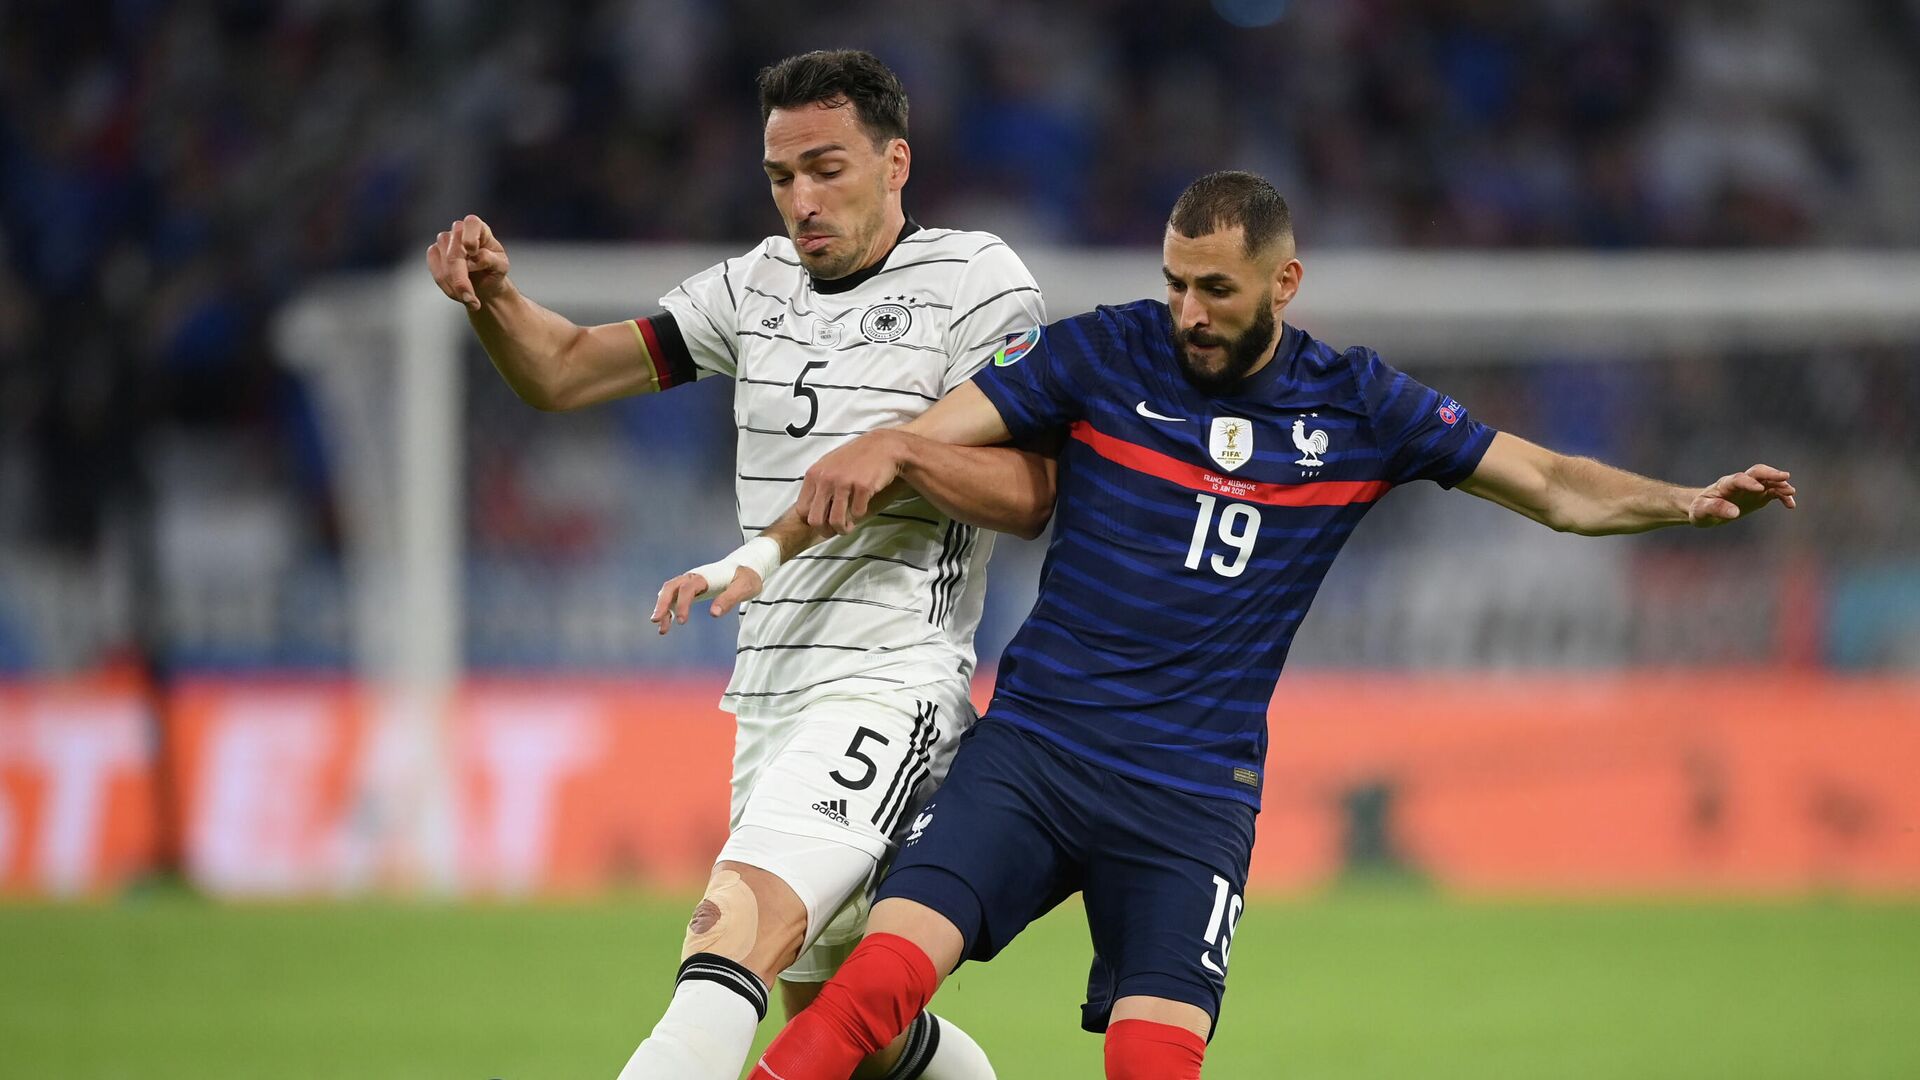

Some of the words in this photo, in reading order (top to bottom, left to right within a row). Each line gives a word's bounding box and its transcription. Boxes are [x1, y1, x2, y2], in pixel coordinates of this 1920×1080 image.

[786, 361, 829, 438] 5
[1222, 450, 1240, 458] FIFA
[1204, 474, 1223, 485] FRANCE
[1227, 480, 1256, 492] ALLEMAGNE
[1231, 487, 1246, 496] 2021
[1184, 493, 1262, 578] 19
[829, 726, 890, 790] 5
[811, 803, 850, 826] adidas
